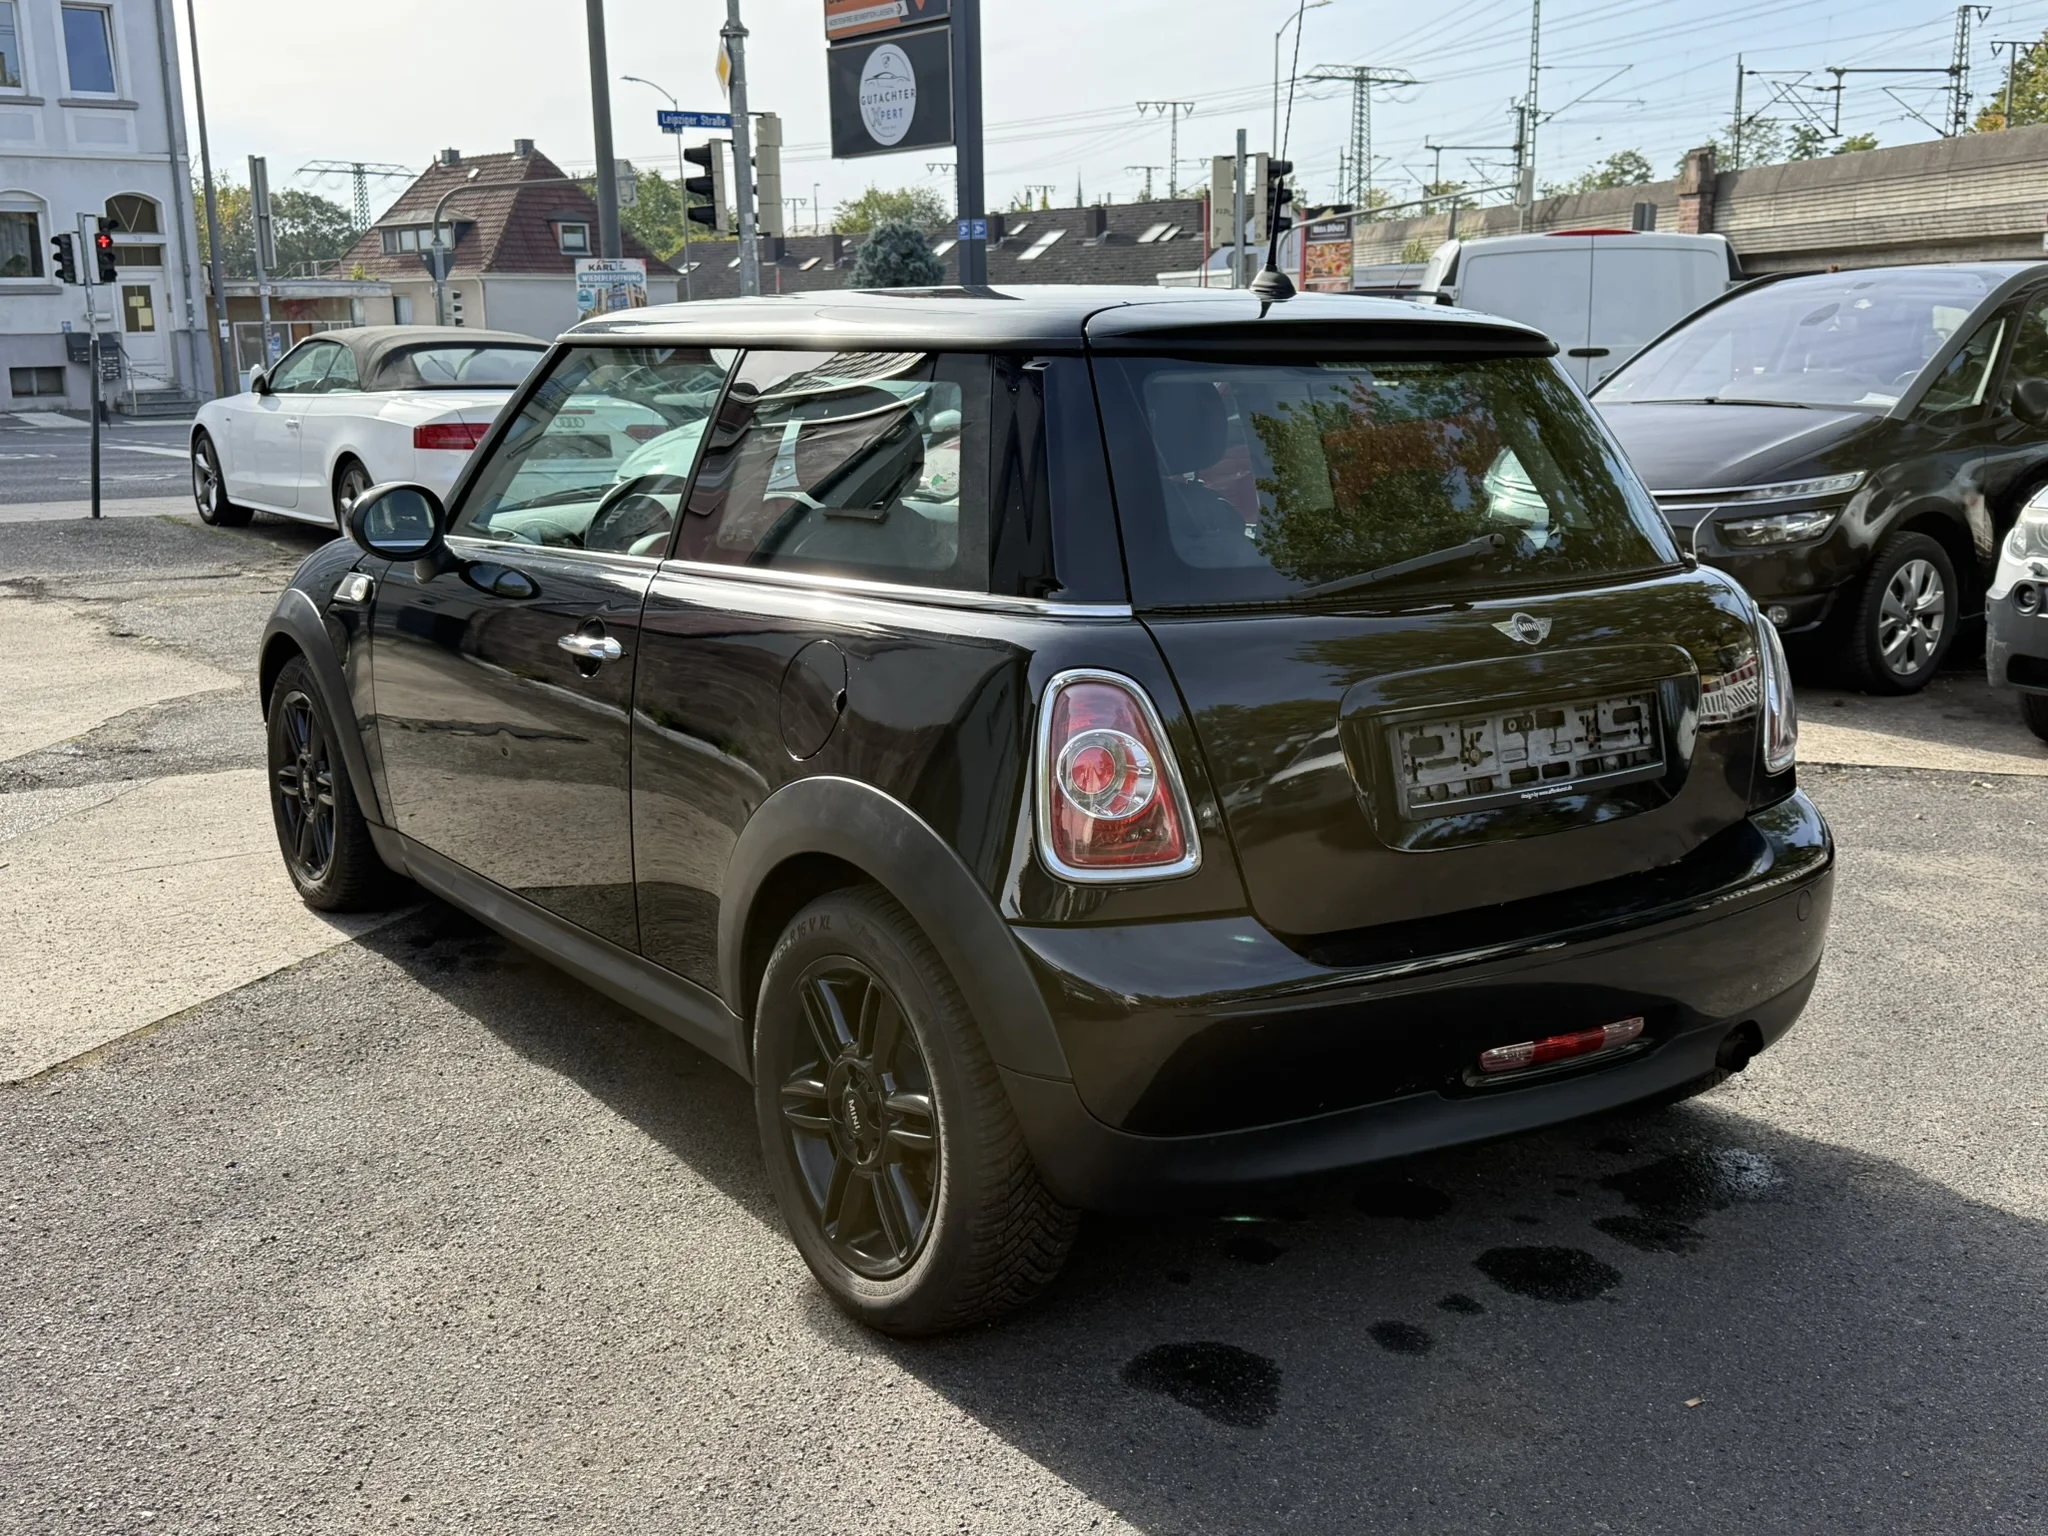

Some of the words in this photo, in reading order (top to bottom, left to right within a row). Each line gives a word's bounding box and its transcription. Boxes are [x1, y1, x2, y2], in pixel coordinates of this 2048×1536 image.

[861, 88, 916, 106] GUTACHTER
[661, 112, 698, 127] Leipziger
[700, 114, 727, 127] Straße
[588, 263, 616, 272] KARL
[1517, 622, 1539, 632] MINI
[848, 1098, 861, 1130] MINI
